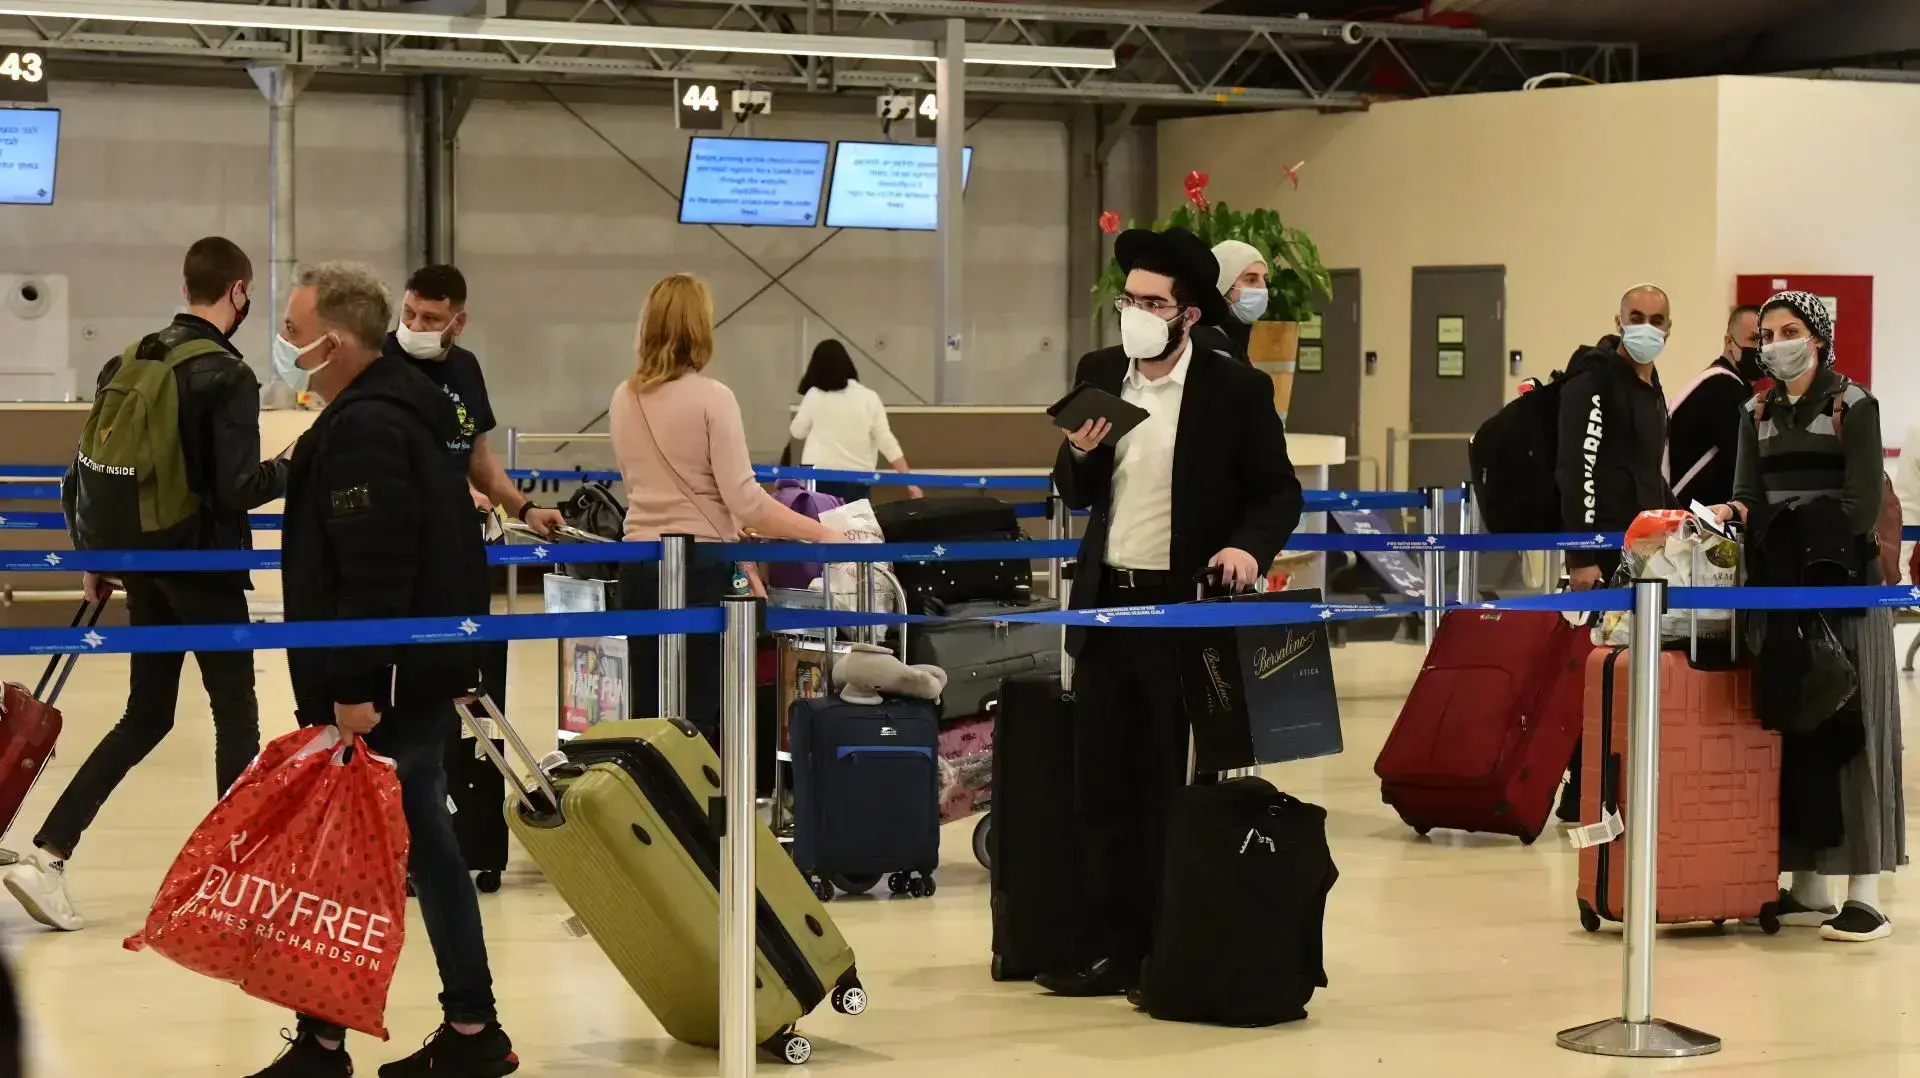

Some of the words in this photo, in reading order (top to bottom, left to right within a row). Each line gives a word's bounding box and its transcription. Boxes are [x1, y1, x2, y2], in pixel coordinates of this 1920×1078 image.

[0, 53, 42, 82] 43
[683, 85, 718, 111] 44
[919, 94, 938, 120] 4
[106, 466, 135, 476] INSIDE
[1254, 628, 1314, 676] Borsalino
[198, 864, 292, 919] DUTY
[289, 891, 390, 953] FREE
[188, 902, 248, 930] JAMES
[255, 922, 381, 972] RICHARDSON
